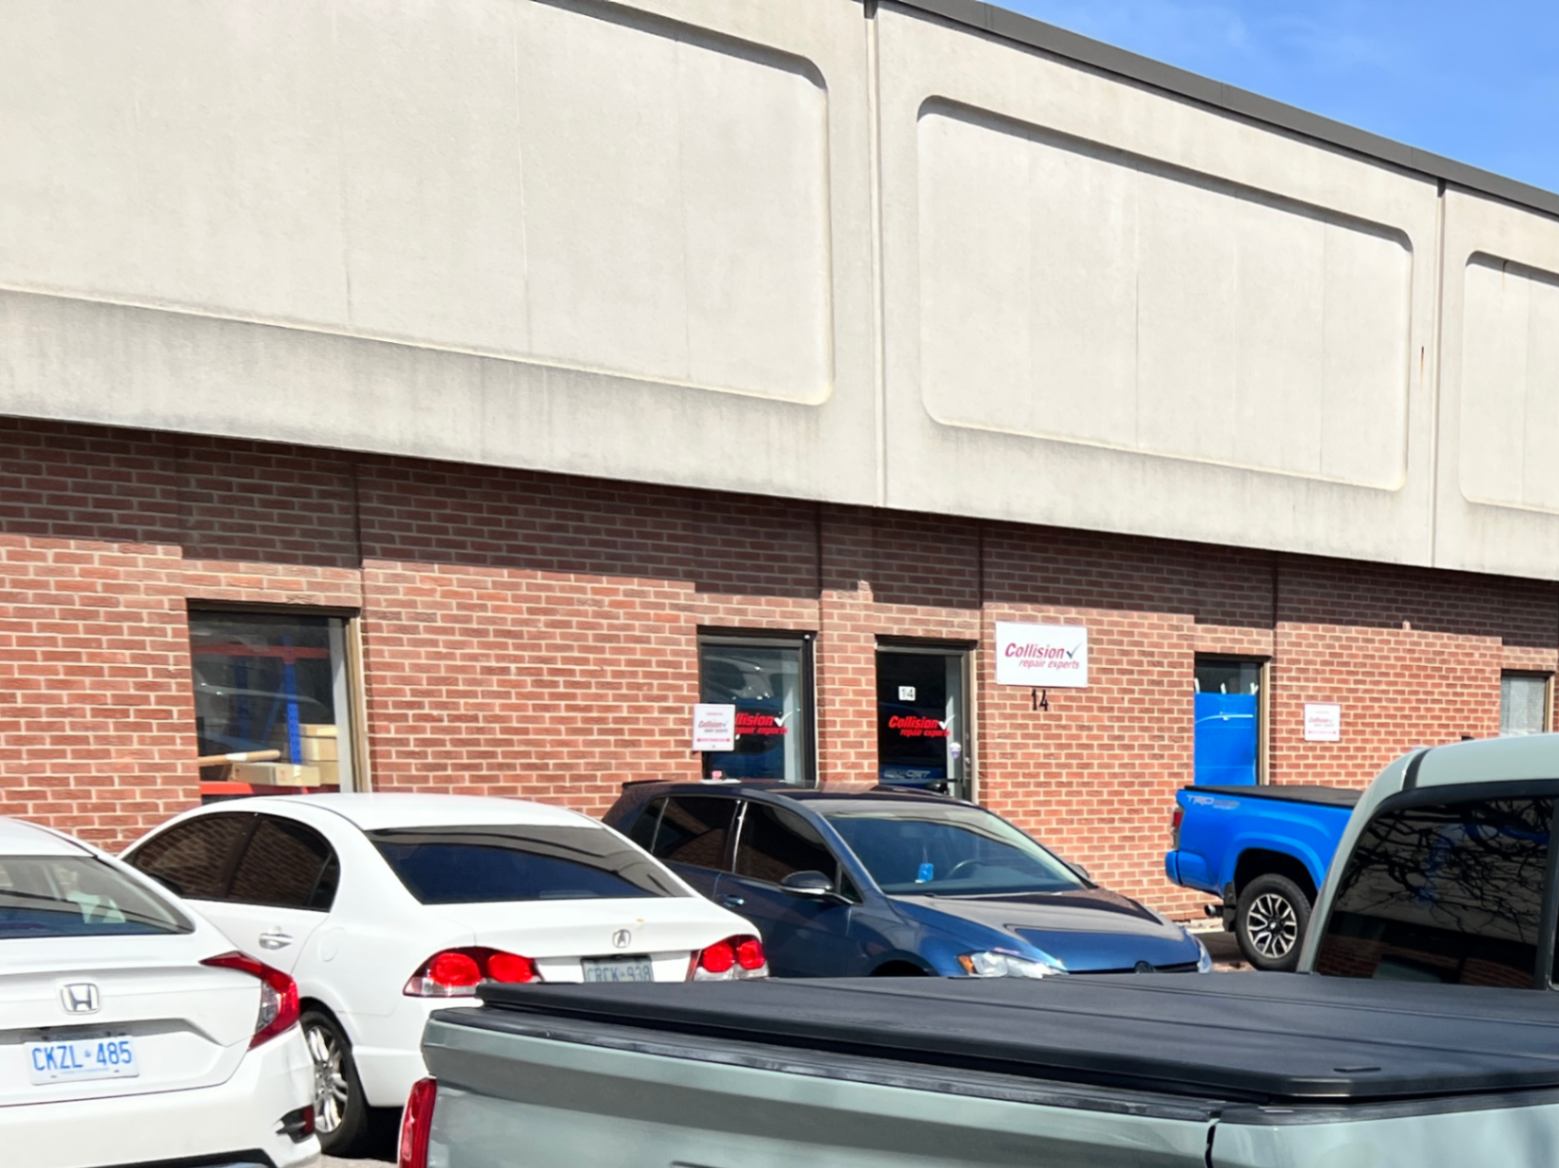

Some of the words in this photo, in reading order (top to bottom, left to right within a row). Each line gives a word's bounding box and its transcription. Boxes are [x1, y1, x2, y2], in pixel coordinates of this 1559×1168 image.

[1004, 642, 1065, 659] Collision
[1019, 660, 1046, 669] repair
[1048, 661, 1080, 670] experts
[902, 688, 914, 698] 14
[1031, 688, 1048, 711] 14
[889, 715, 939, 729] Collision
[31, 1044, 84, 1072] CKZL
[96, 1040, 133, 1066] 485
